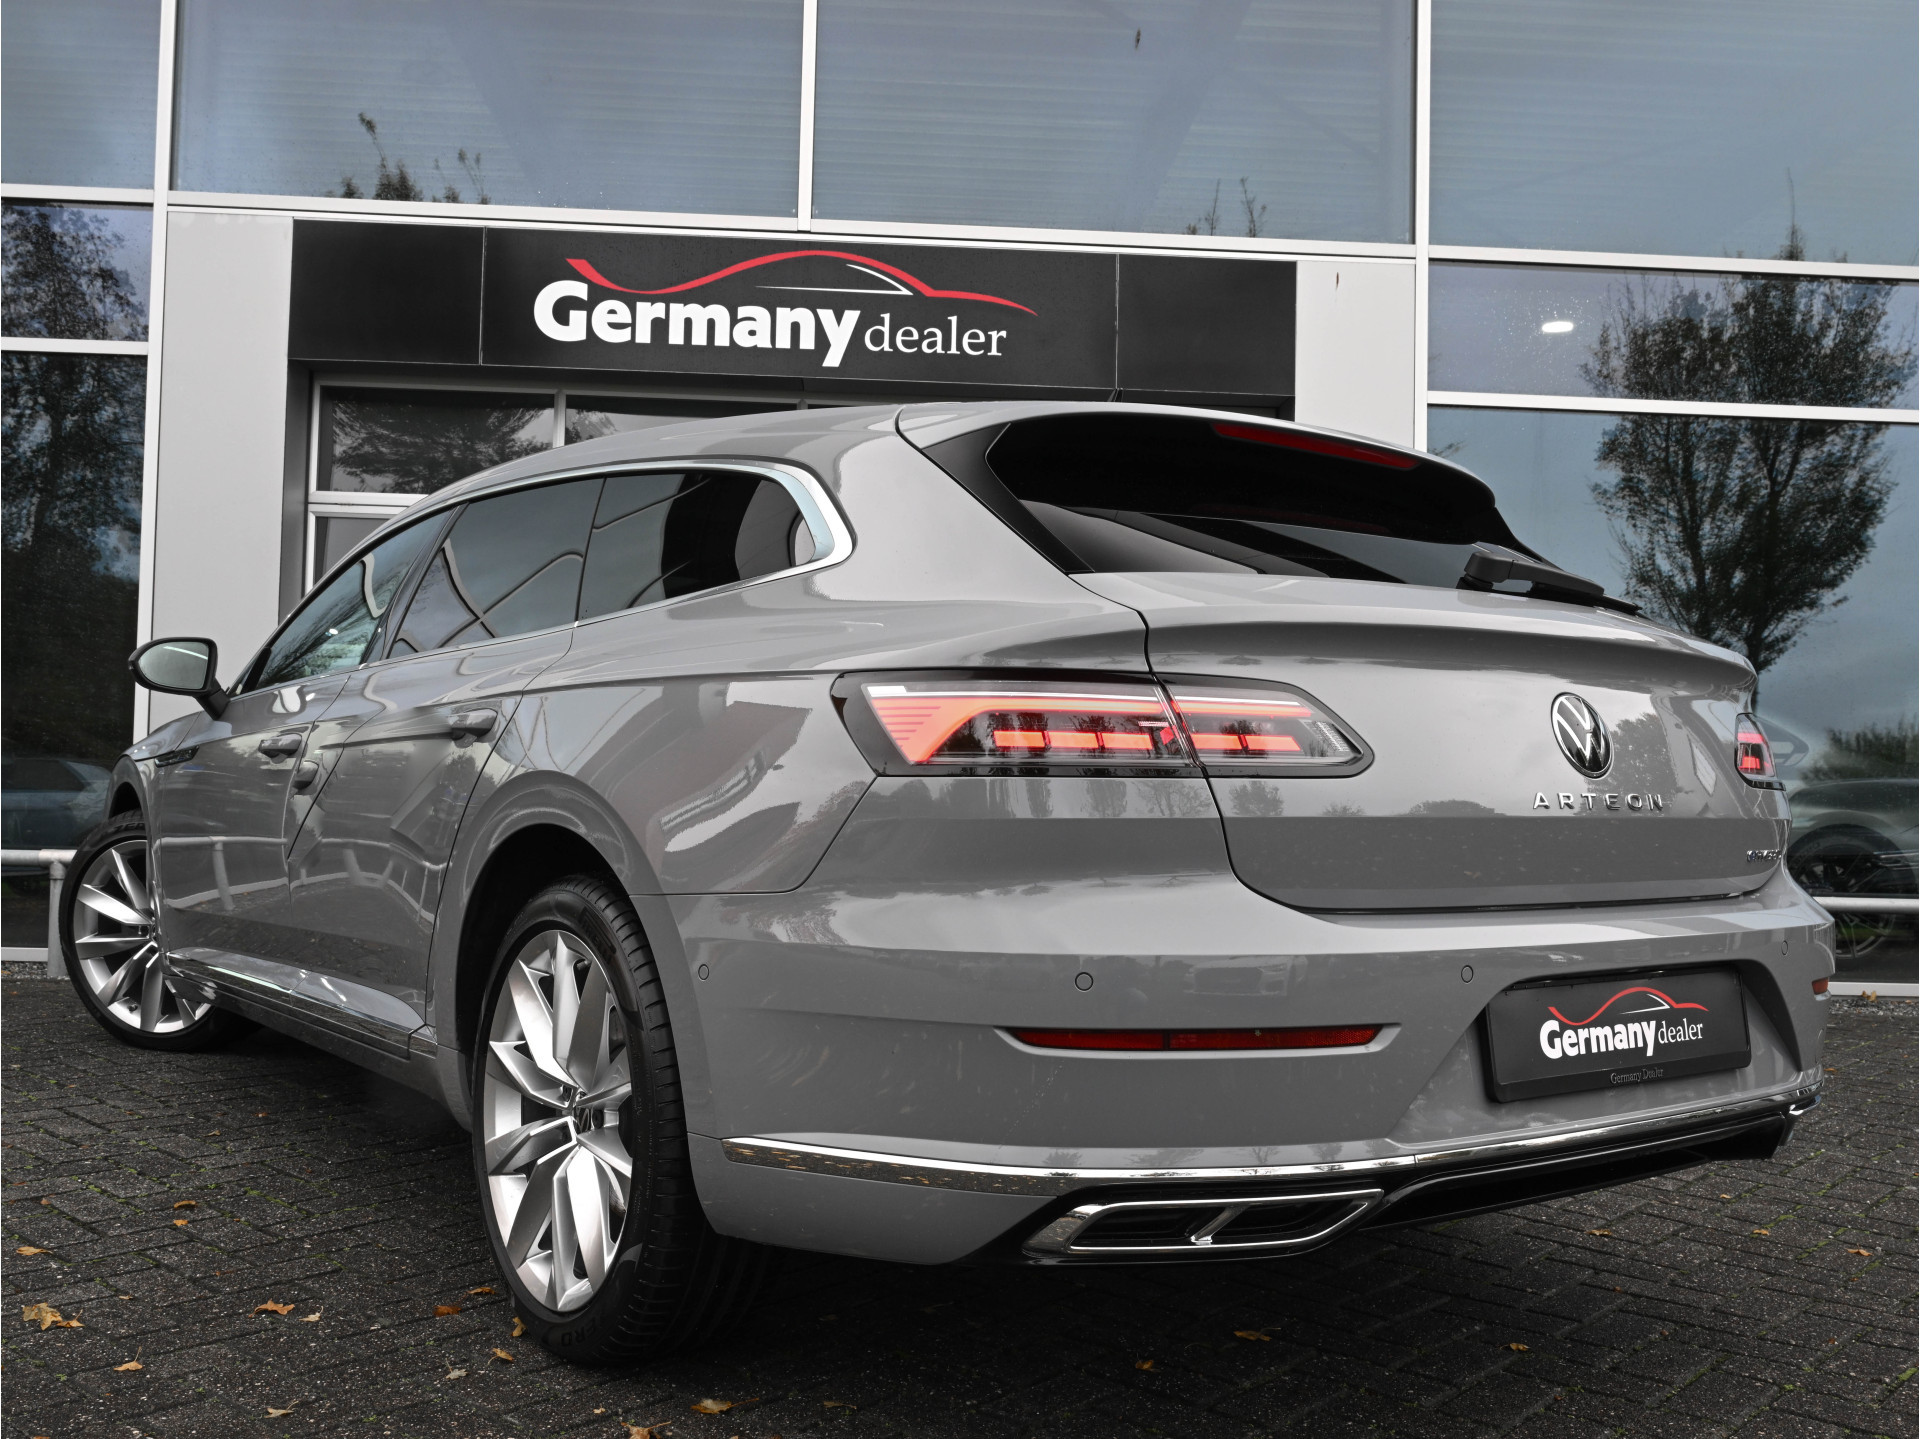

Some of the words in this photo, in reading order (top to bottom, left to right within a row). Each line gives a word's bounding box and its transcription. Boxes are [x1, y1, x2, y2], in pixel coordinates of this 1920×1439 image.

[533, 279, 861, 368] Germany
[864, 312, 1007, 356] dealer
[1533, 791, 1664, 811] ARTEON
[1539, 1019, 1657, 1059] Germany
[1657, 1017, 1704, 1045] dealer
[1610, 1072, 1642, 1084] Germany
[1642, 1066, 1664, 1080] Dealer
